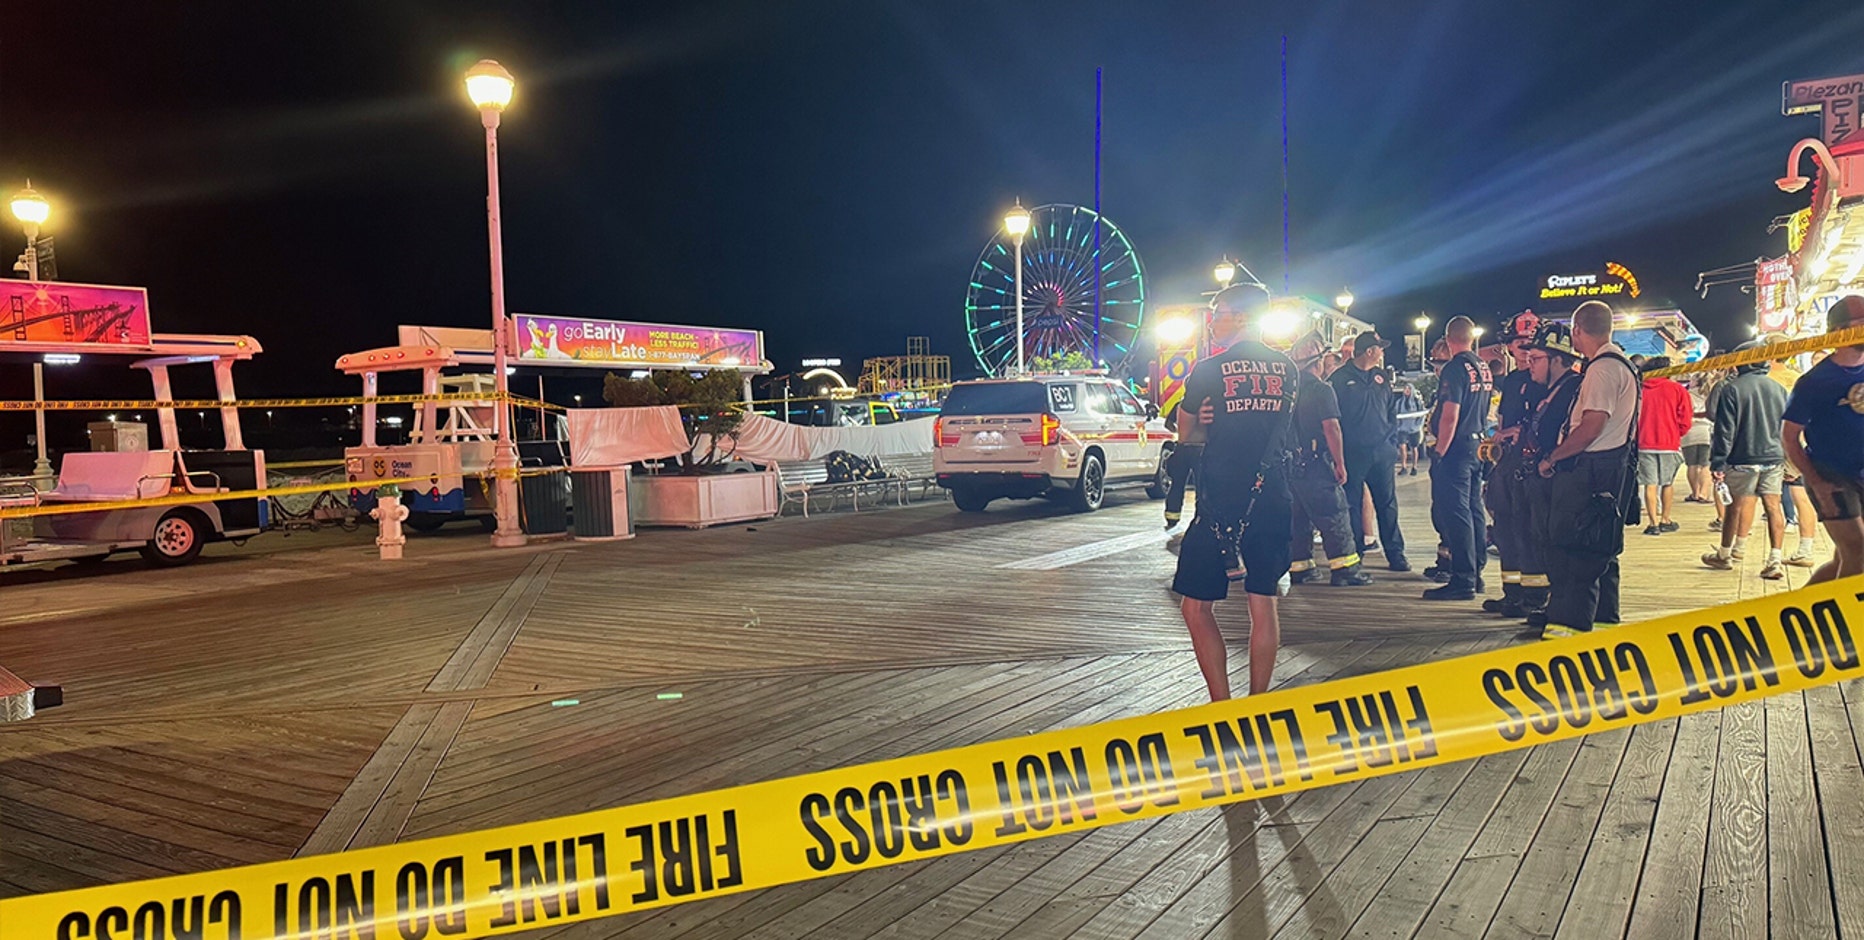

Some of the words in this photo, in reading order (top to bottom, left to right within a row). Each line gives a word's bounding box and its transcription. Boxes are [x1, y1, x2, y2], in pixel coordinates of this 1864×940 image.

[1831, 98, 1853, 144] PIZ
[1540, 288, 1577, 299] Believe
[1577, 285, 1588, 296] It
[1588, 286, 1601, 295] or
[1600, 282, 1625, 295] Not!
[649, 331, 669, 339] MORE
[670, 332, 694, 340] BEACH
[650, 339, 667, 348] LESS
[1221, 360, 1269, 376] OCEAN
[1222, 374, 1283, 398] FIR
[1225, 398, 1282, 413] DEPARTM
[391, 460, 412, 469] Ocean
[1667, 616, 1781, 706] NOT
[1780, 598, 1861, 680] DO
[1313, 685, 1439, 776] FIRE
[1481, 642, 1659, 742] CROSS
[991, 746, 1098, 838] NOT
[1104, 732, 1180, 814] DO
[1183, 708, 1314, 801] LINE
[625, 808, 744, 905] FIRE
[799, 768, 974, 872] CROSS
[274, 869, 375, 940] NOT
[395, 855, 467, 940] DO
[484, 832, 611, 929] LINE
